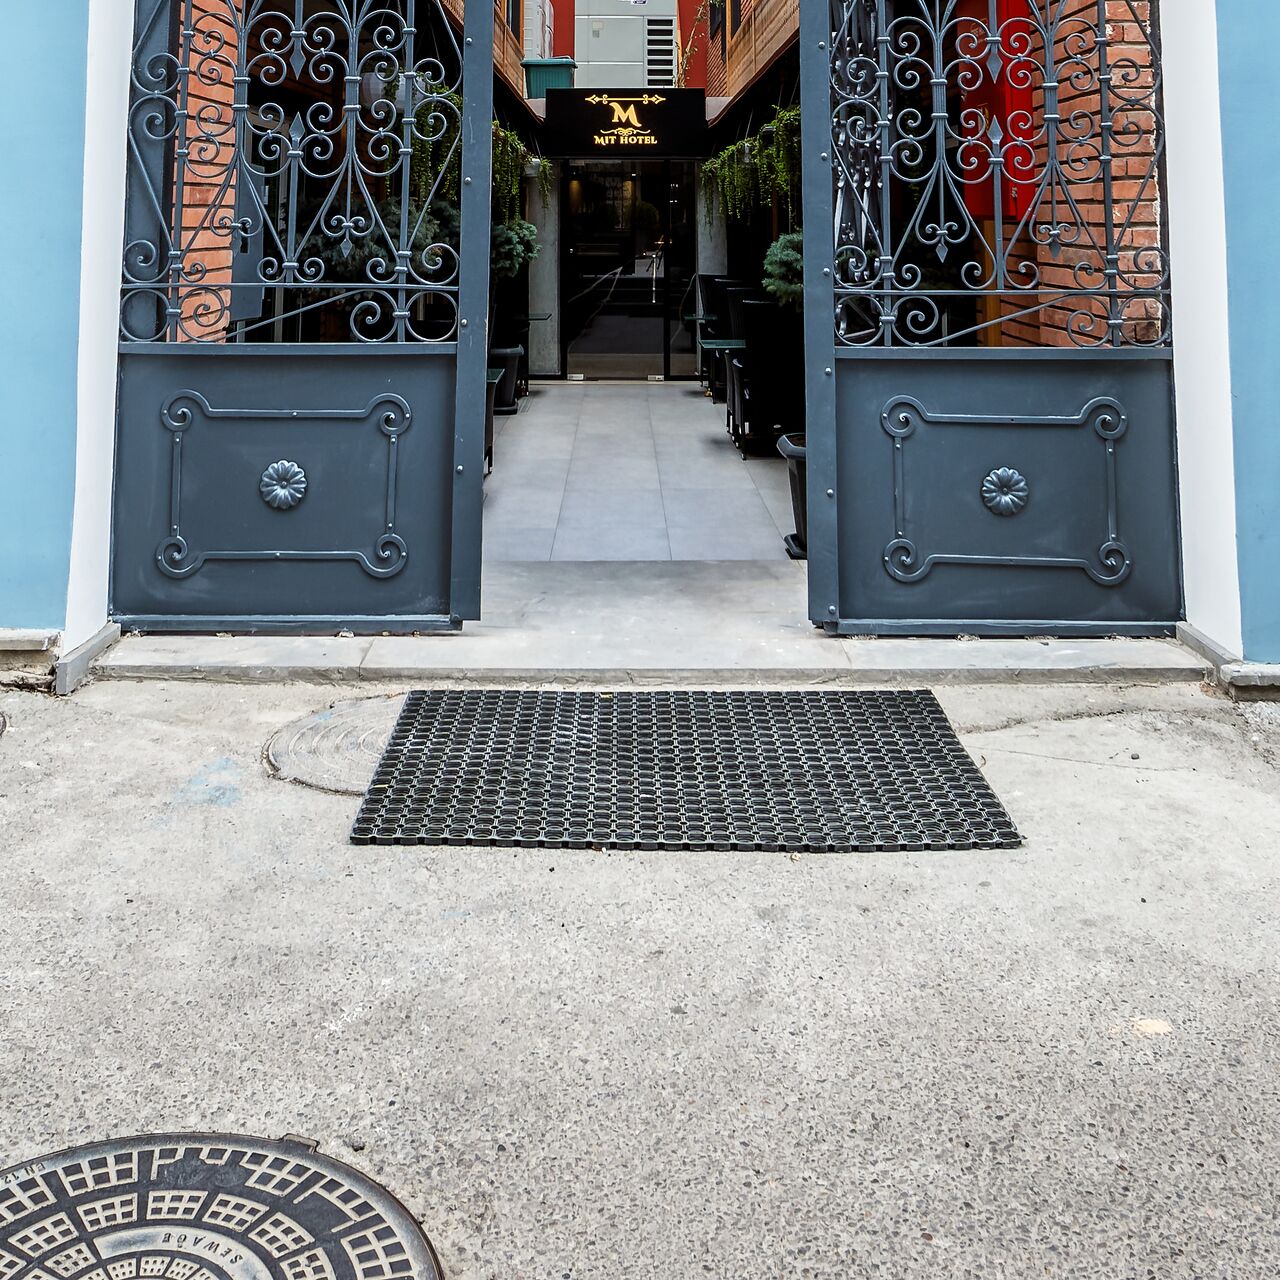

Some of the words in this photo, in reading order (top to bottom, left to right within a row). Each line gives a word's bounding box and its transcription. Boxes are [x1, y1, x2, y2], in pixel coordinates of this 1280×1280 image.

[608, 102, 642, 127] M
[593, 135, 617, 146] MIT
[620, 135, 658, 145] HOTEL
